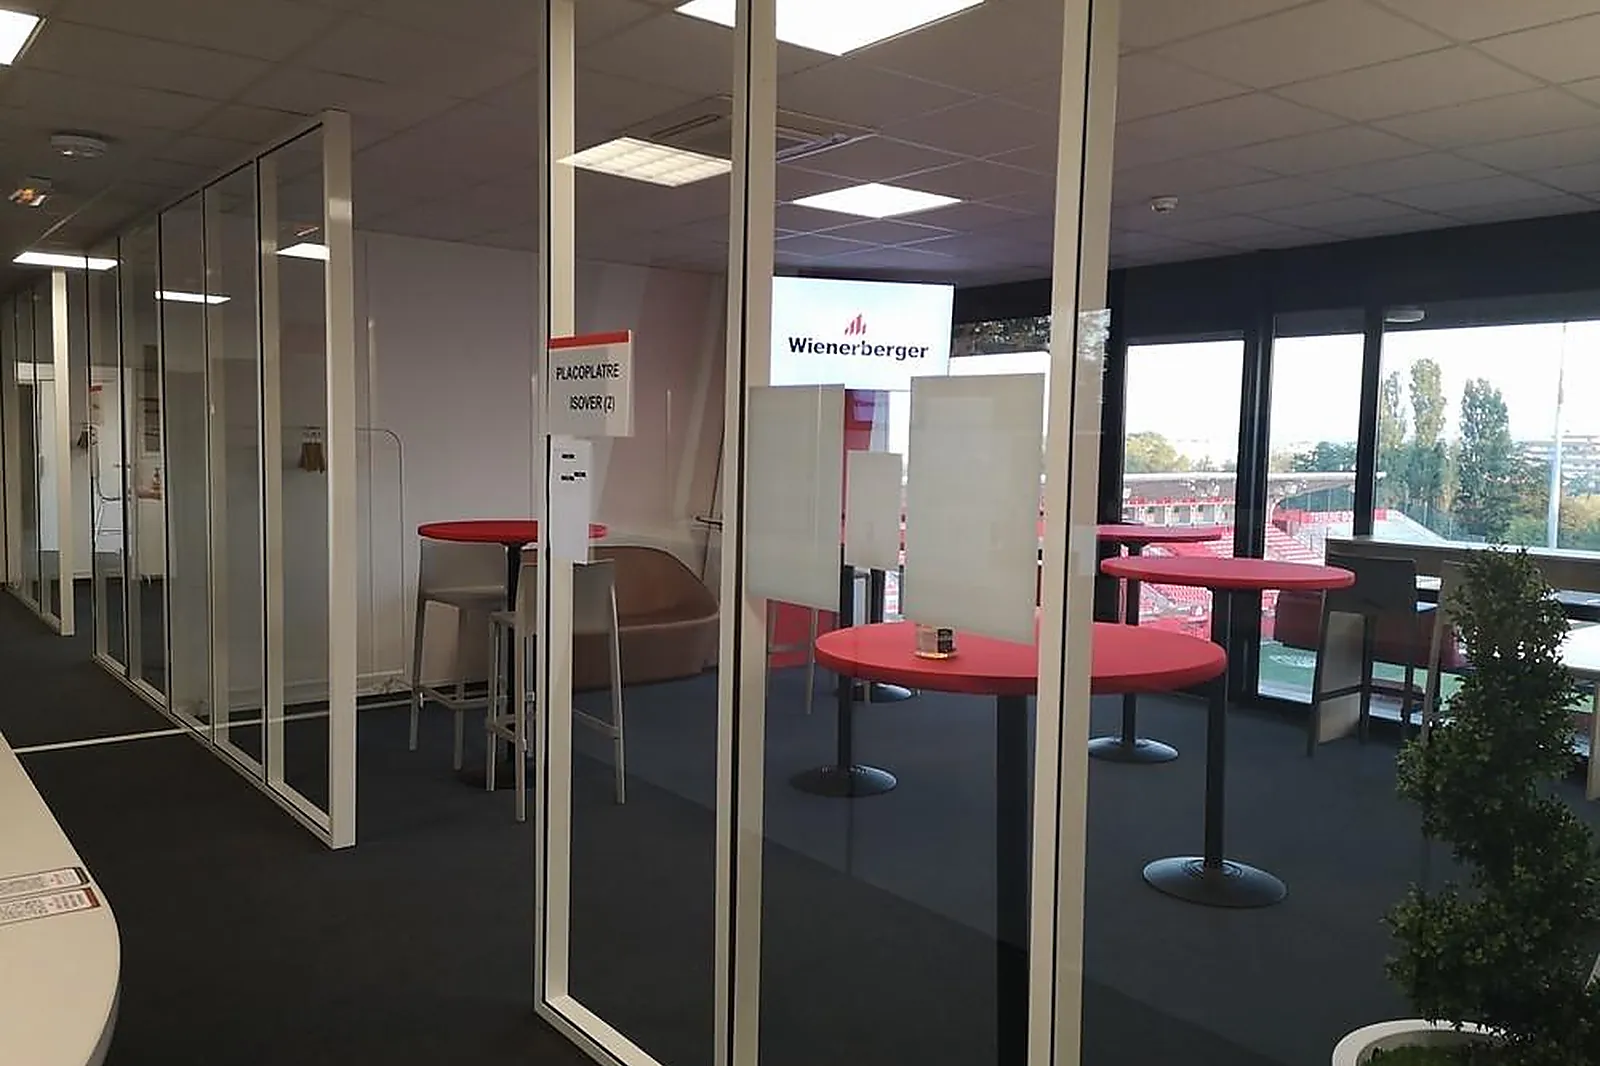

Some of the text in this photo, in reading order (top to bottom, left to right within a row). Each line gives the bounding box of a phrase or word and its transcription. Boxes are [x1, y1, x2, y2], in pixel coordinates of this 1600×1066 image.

[788, 337, 929, 361] Wienerberger
[556, 363, 620, 380] PLACOPLATRE
[570, 395, 603, 410] ISOVER
